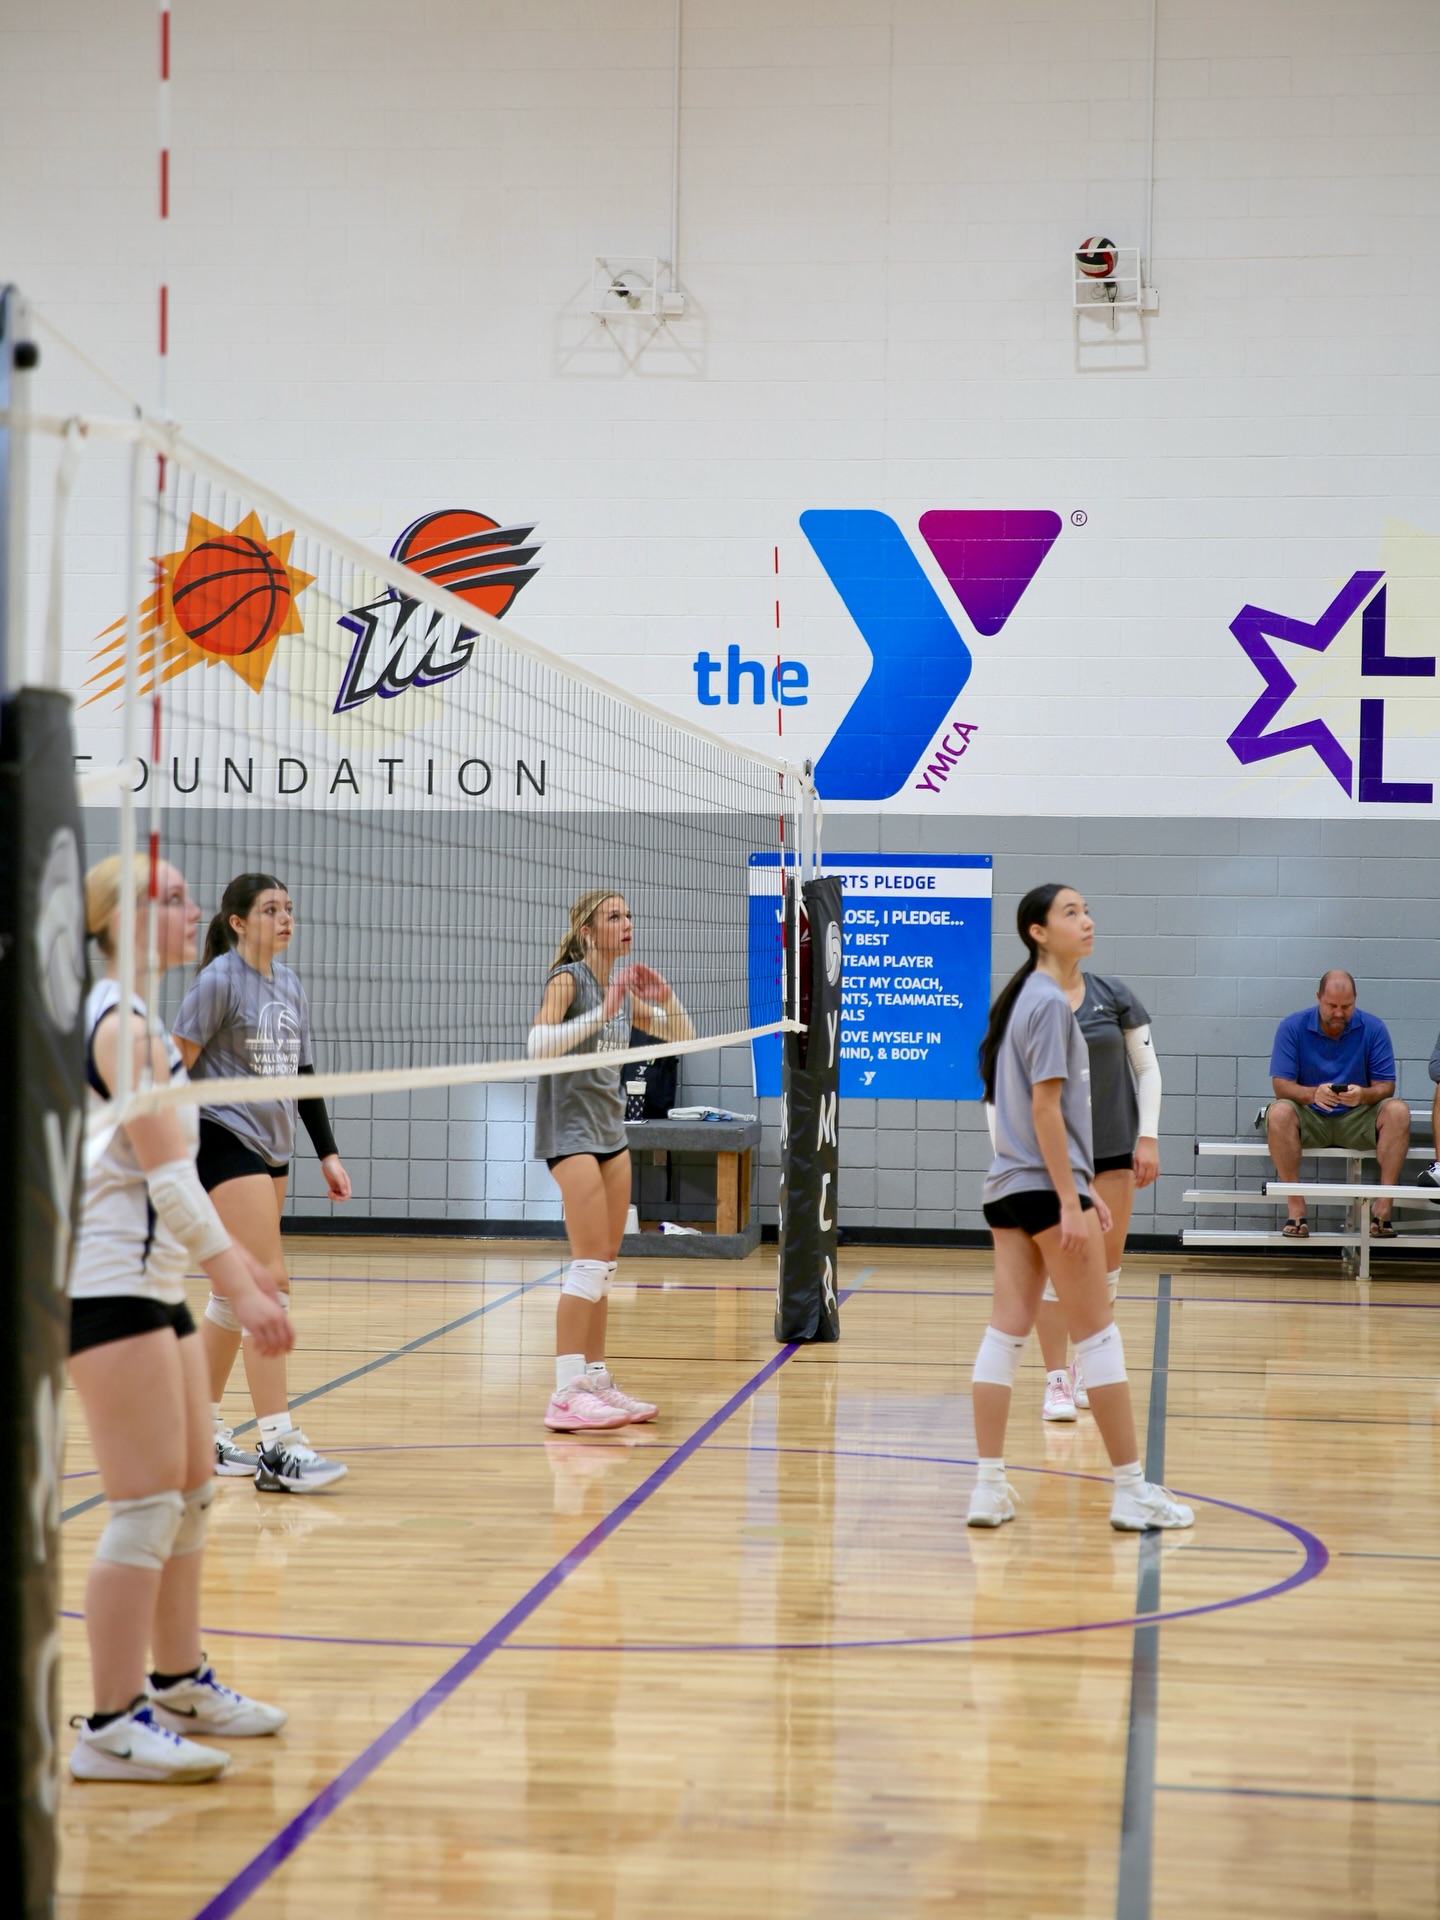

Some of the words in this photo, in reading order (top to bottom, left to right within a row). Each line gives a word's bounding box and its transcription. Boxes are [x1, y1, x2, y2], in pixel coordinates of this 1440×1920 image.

[693, 644, 809, 706] the
[915, 721, 979, 794] YMCA
[874, 875, 936, 889] PLEDGE
[842, 909, 880, 927] OSE,
[883, 910, 889, 924] I
[892, 910, 964, 926] PLEDGE...
[855, 933, 889, 946] BEST
[842, 955, 880, 967] TEAM
[883, 956, 934, 968] PLAYER
[869, 977, 891, 989] MY
[893, 977, 943, 992] COACH,
[875, 993, 963, 1009] TEAMMATES,
[872, 1031, 924, 1044] MYSELF
[926, 1032, 941, 1044] IN
[877, 1047, 888, 1060] &
[891, 1048, 929, 1060] BODY
